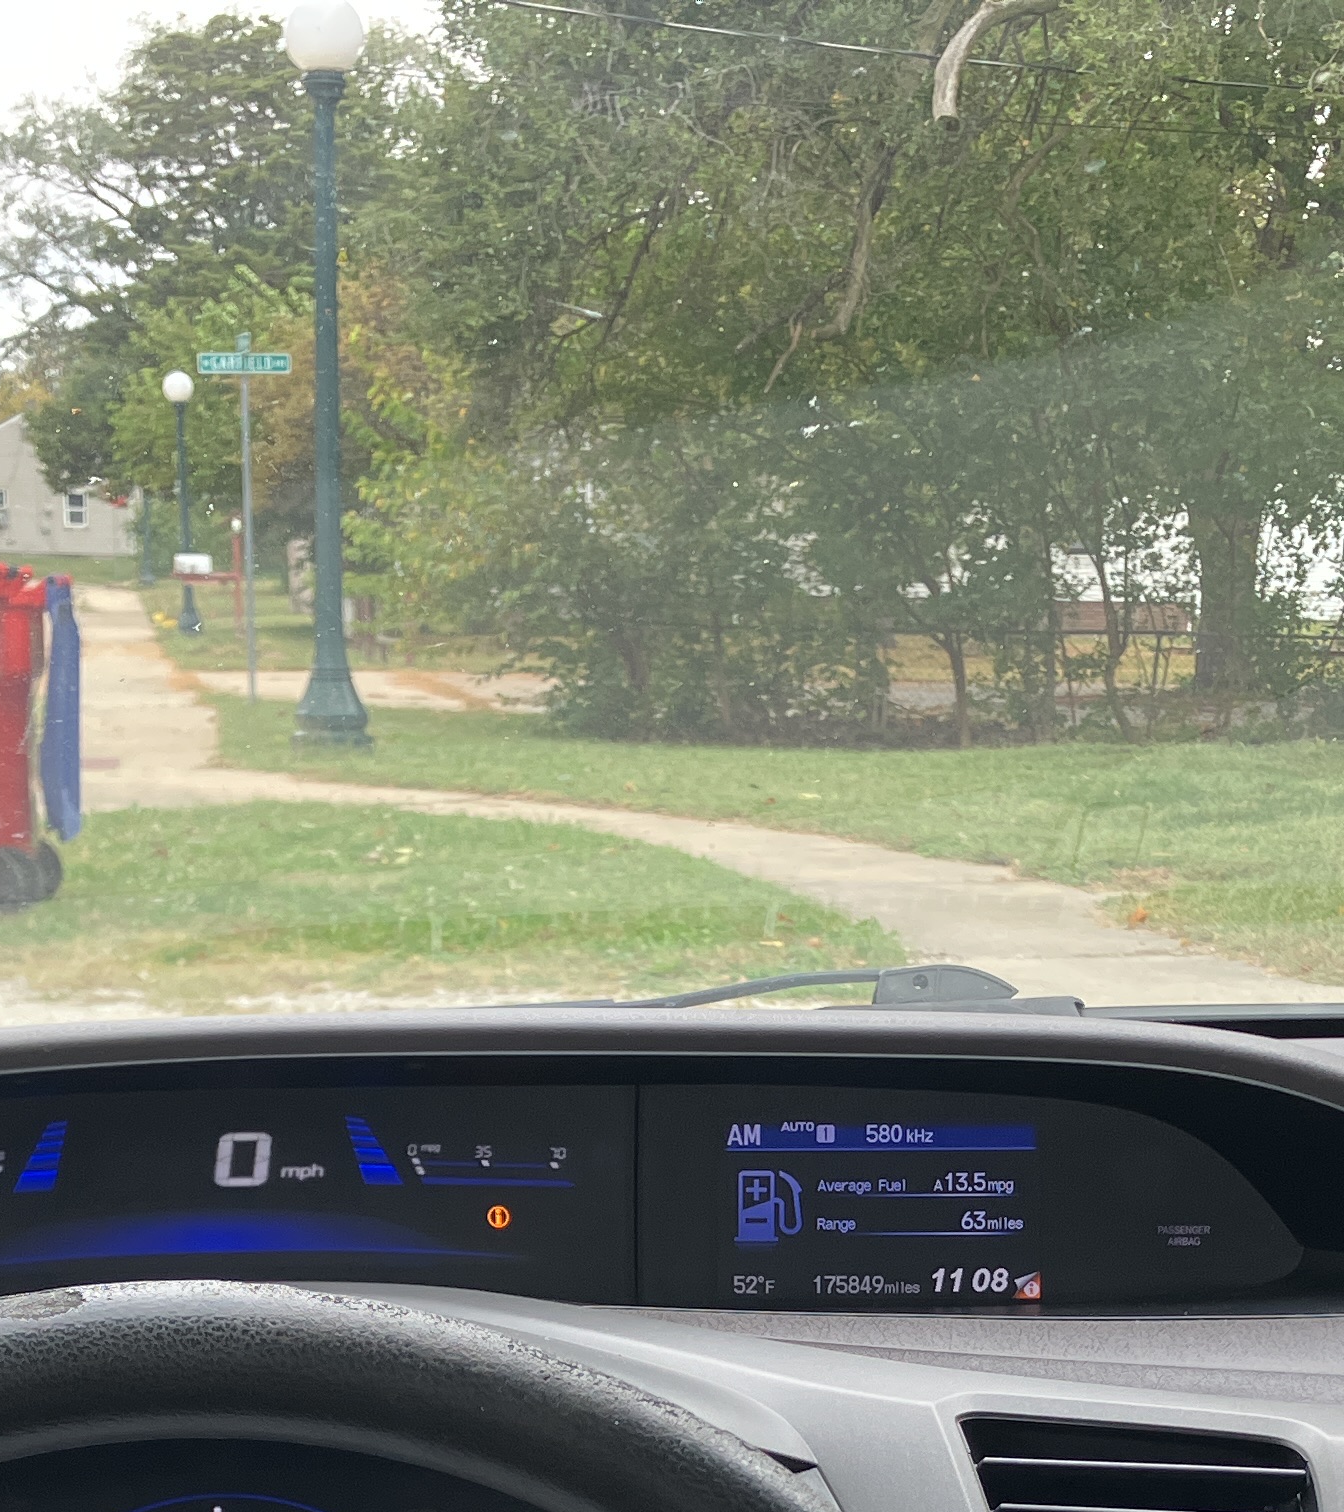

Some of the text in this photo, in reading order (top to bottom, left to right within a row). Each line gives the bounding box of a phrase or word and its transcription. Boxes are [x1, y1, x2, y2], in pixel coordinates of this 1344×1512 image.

[727, 1124, 762, 1146] AM
[780, 1121, 814, 1133] AUTO
[865, 1124, 903, 1144] 580
[906, 1127, 934, 1144] kHz
[214, 1132, 325, 1188] 0 mph
[474, 1145, 494, 1159] 35
[816, 1178, 872, 1195] Average
[877, 1178, 907, 1192] Fuel
[816, 1217, 856, 1233] Range
[1157, 1226, 1211, 1235] PASSENGER
[1167, 1236, 1202, 1246] AIRBAG
